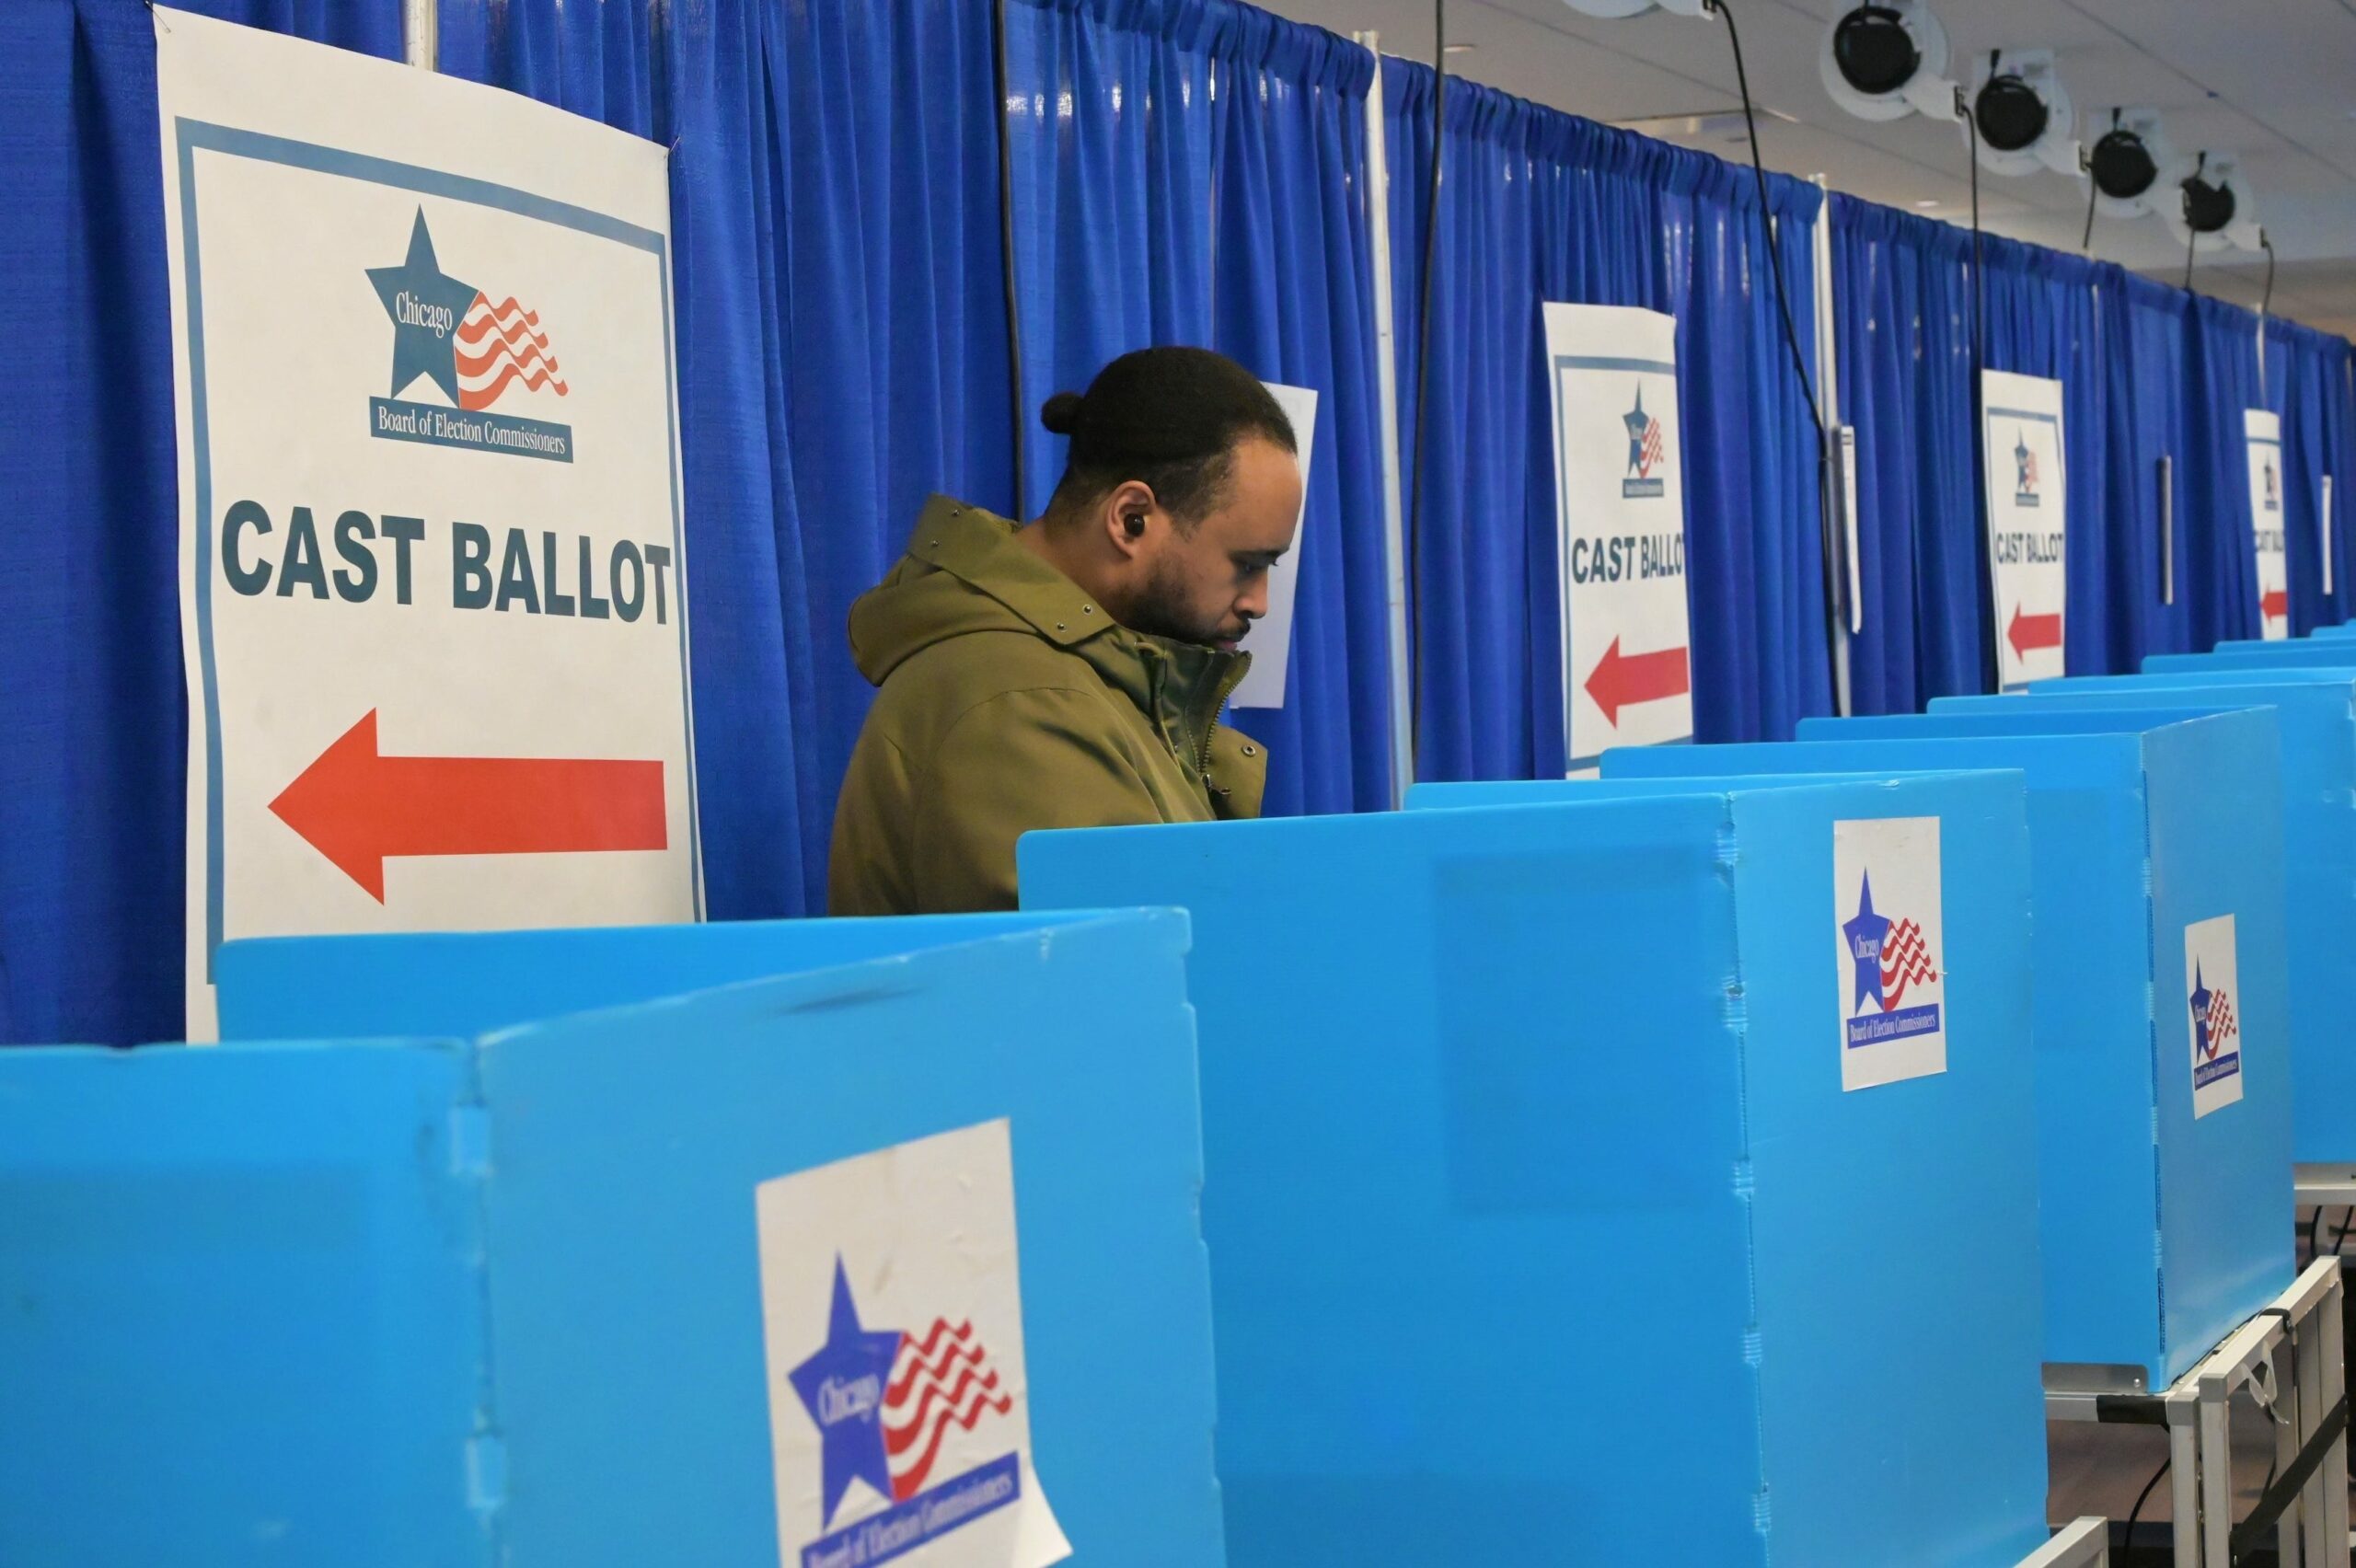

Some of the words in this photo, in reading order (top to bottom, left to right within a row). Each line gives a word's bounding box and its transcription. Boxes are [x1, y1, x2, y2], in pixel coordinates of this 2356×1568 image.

[396, 292, 452, 339] Chicago
[378, 406, 416, 434] Board
[419, 411, 433, 436] of
[435, 413, 482, 442] Election
[484, 421, 565, 455] Commissioners
[222, 500, 425, 605] CAST
[452, 521, 671, 625] BALLOT
[1572, 536, 1635, 584] CAST
[1997, 532, 2023, 564] CAST
[2027, 532, 2063, 563] BALLOT
[1854, 933, 1879, 963] Chicago
[1850, 1020, 1866, 1042] Board
[1873, 1018, 1895, 1037] Election
[1896, 1012, 1935, 1033] Commissioners
